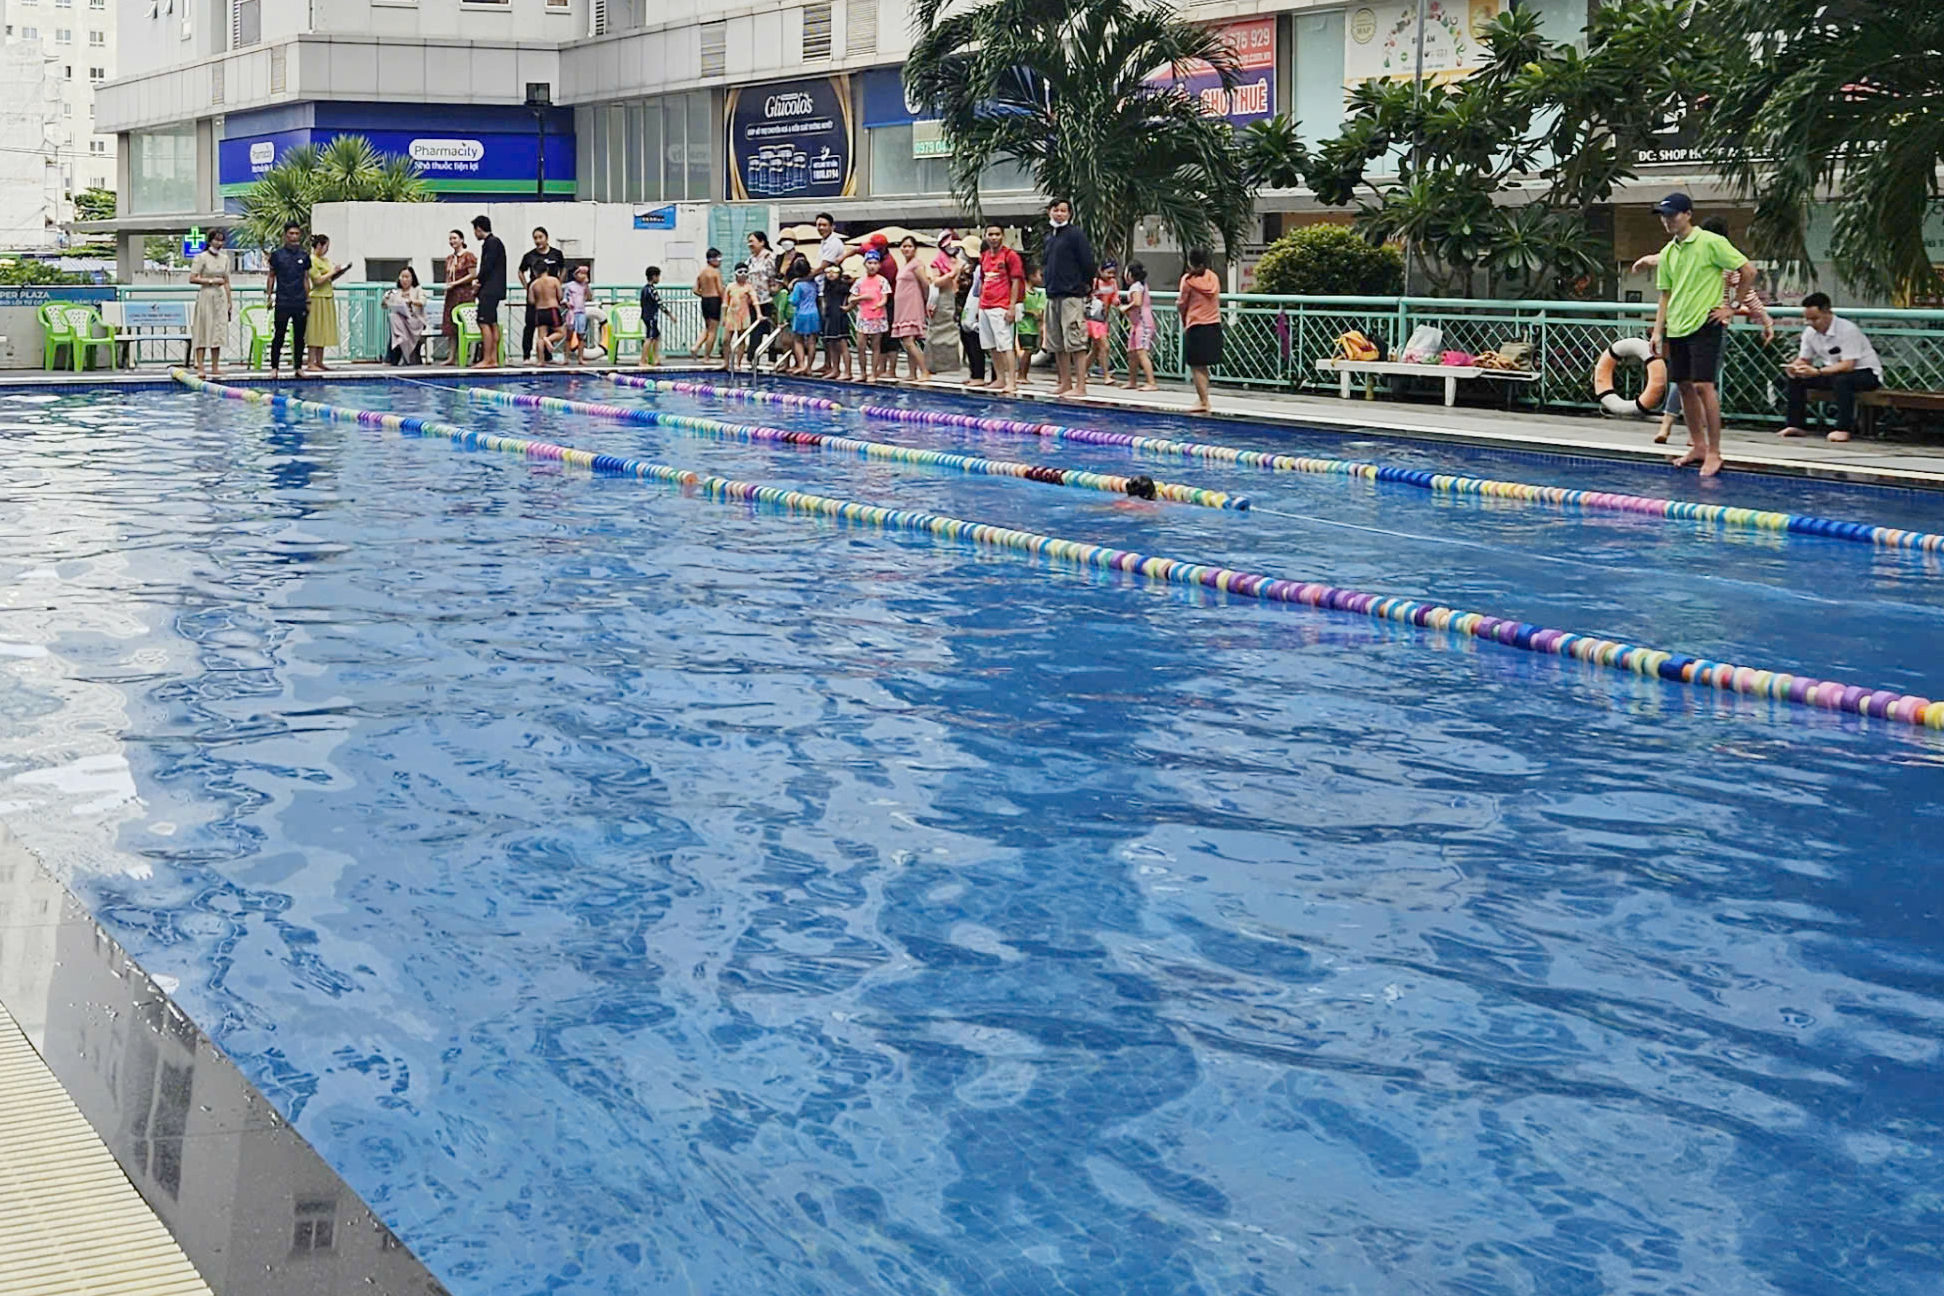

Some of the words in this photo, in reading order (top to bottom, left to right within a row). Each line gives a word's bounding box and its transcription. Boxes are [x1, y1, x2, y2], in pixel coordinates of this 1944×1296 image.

[1251, 28, 1270, 48] 929
[1231, 77, 1268, 115] THUÊ
[414, 143, 478, 158] Pharmacity
[1659, 150, 1686, 161] SHOP
[20, 291, 50, 299] PLAZA
